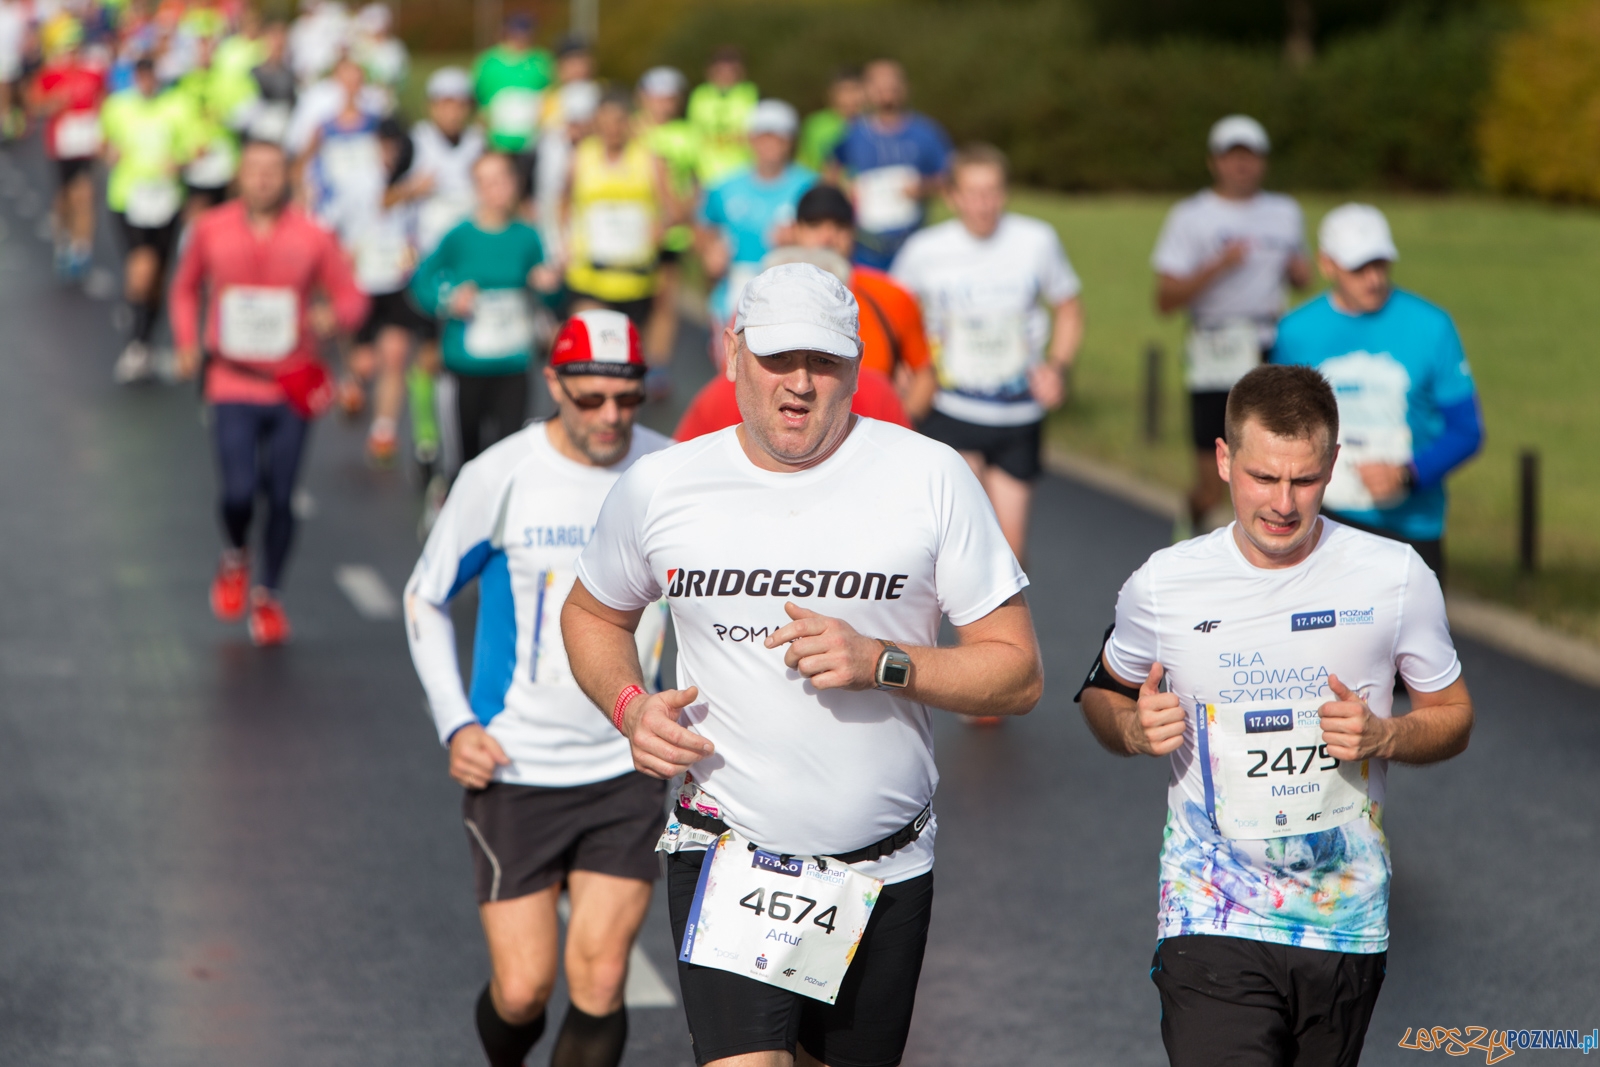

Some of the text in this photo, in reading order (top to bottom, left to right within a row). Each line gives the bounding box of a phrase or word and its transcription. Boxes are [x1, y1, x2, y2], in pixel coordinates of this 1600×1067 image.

[667, 568, 908, 600] BRIDGESTONE
[1193, 620, 1222, 633] 4F
[1296, 617, 1309, 627] 17.
[1310, 614, 1333, 626] PKO
[1340, 615, 1374, 623] maraton
[1219, 652, 1265, 668] SIŁA
[1233, 666, 1329, 685] ODWAGA
[1249, 715, 1290, 728] 17. PKO
[1298, 717, 1321, 726] mara
[1271, 780, 1320, 797] Marcin
[1306, 811, 1322, 821] 4F
[758, 855, 799, 872] 17. PKO
[806, 870, 845, 885] maraton
[739, 887, 838, 935] 4674
[766, 928, 802, 947] Artur
[783, 967, 797, 977] 4F
